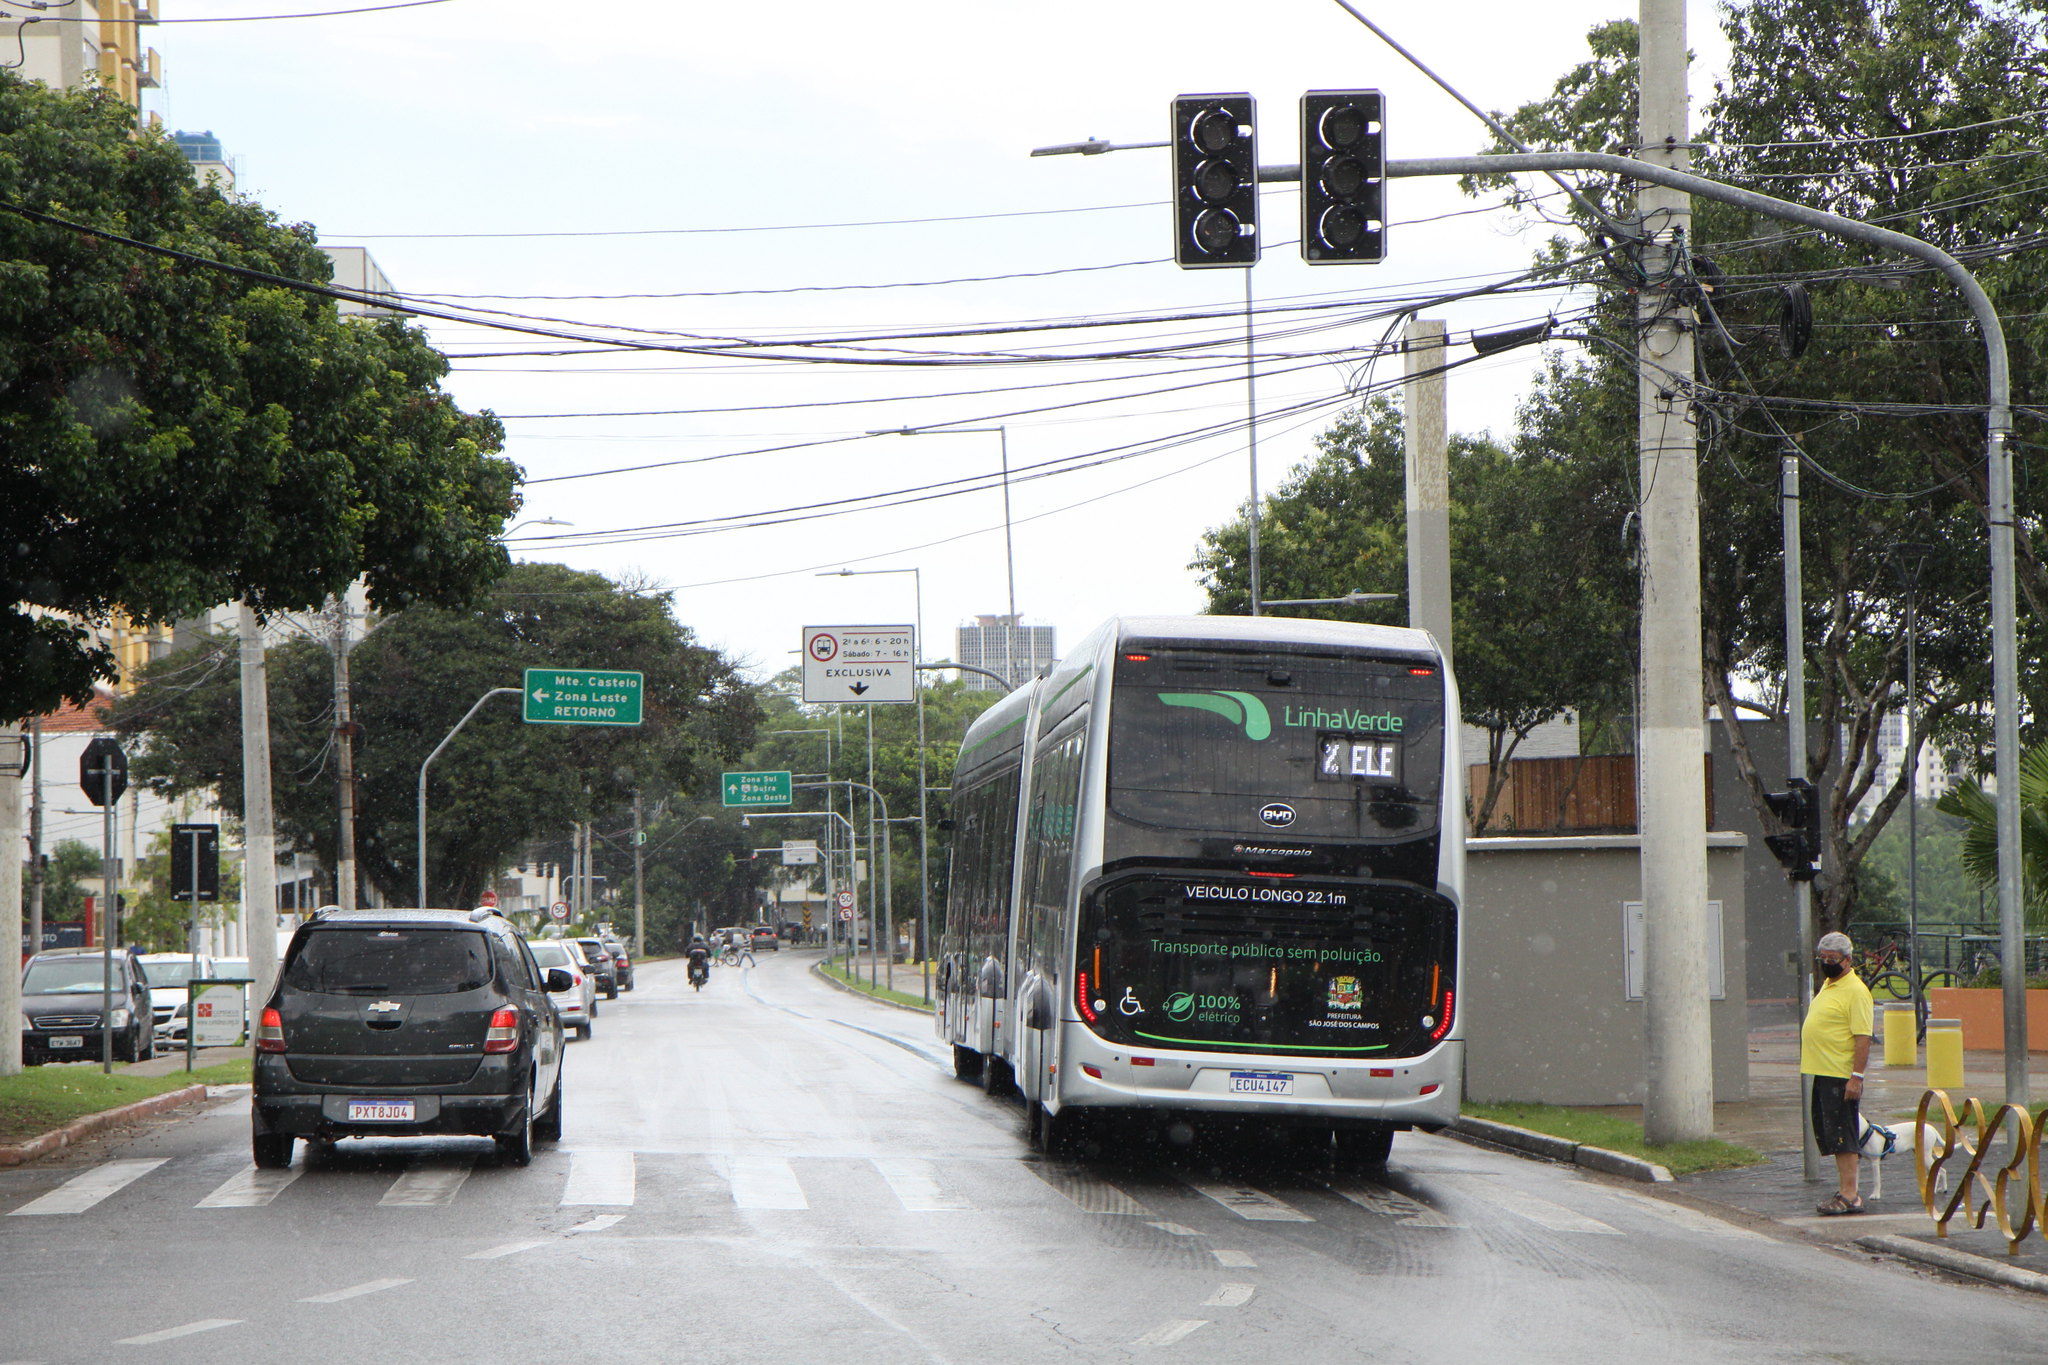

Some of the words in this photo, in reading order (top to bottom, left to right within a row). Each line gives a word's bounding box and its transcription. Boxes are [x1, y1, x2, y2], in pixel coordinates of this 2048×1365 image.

[890, 637, 901, 645] 20
[904, 637, 909, 645] h
[904, 649, 909, 657] h
[826, 668, 892, 677] EXCLUSIVA
[555, 676, 584, 686] Mte.
[588, 676, 638, 688] Castelo
[555, 691, 588, 702] Zona
[592, 692, 628, 703] Leste
[554, 706, 616, 718] RETORNO
[1285, 705, 1403, 732] LinhaVerde
[1351, 745, 1393, 776] ELE
[1263, 810, 1292, 821] BYD
[1245, 846, 1313, 857] Marcopolo
[841, 894, 852, 902] 50
[1185, 885, 1248, 900] VEICULO
[1252, 888, 1303, 902] LONGO
[1306, 891, 1347, 904] 22.1m
[554, 905, 565, 913] 50
[1151, 939, 1228, 956] Transporte
[1231, 942, 1284, 959] público
[1287, 946, 1317, 959] sem
[1321, 946, 1385, 965] poluição.
[1199, 994, 1241, 1010] 100%
[1199, 1011, 1241, 1023] elétrico
[1327, 1012, 1362, 1020] PREFEITURA
[1308, 1019, 1322, 1027] SÃO
[1323, 1019, 1338, 1028] JOSÉ
[355, 1106, 408, 1118] PXT8J04
